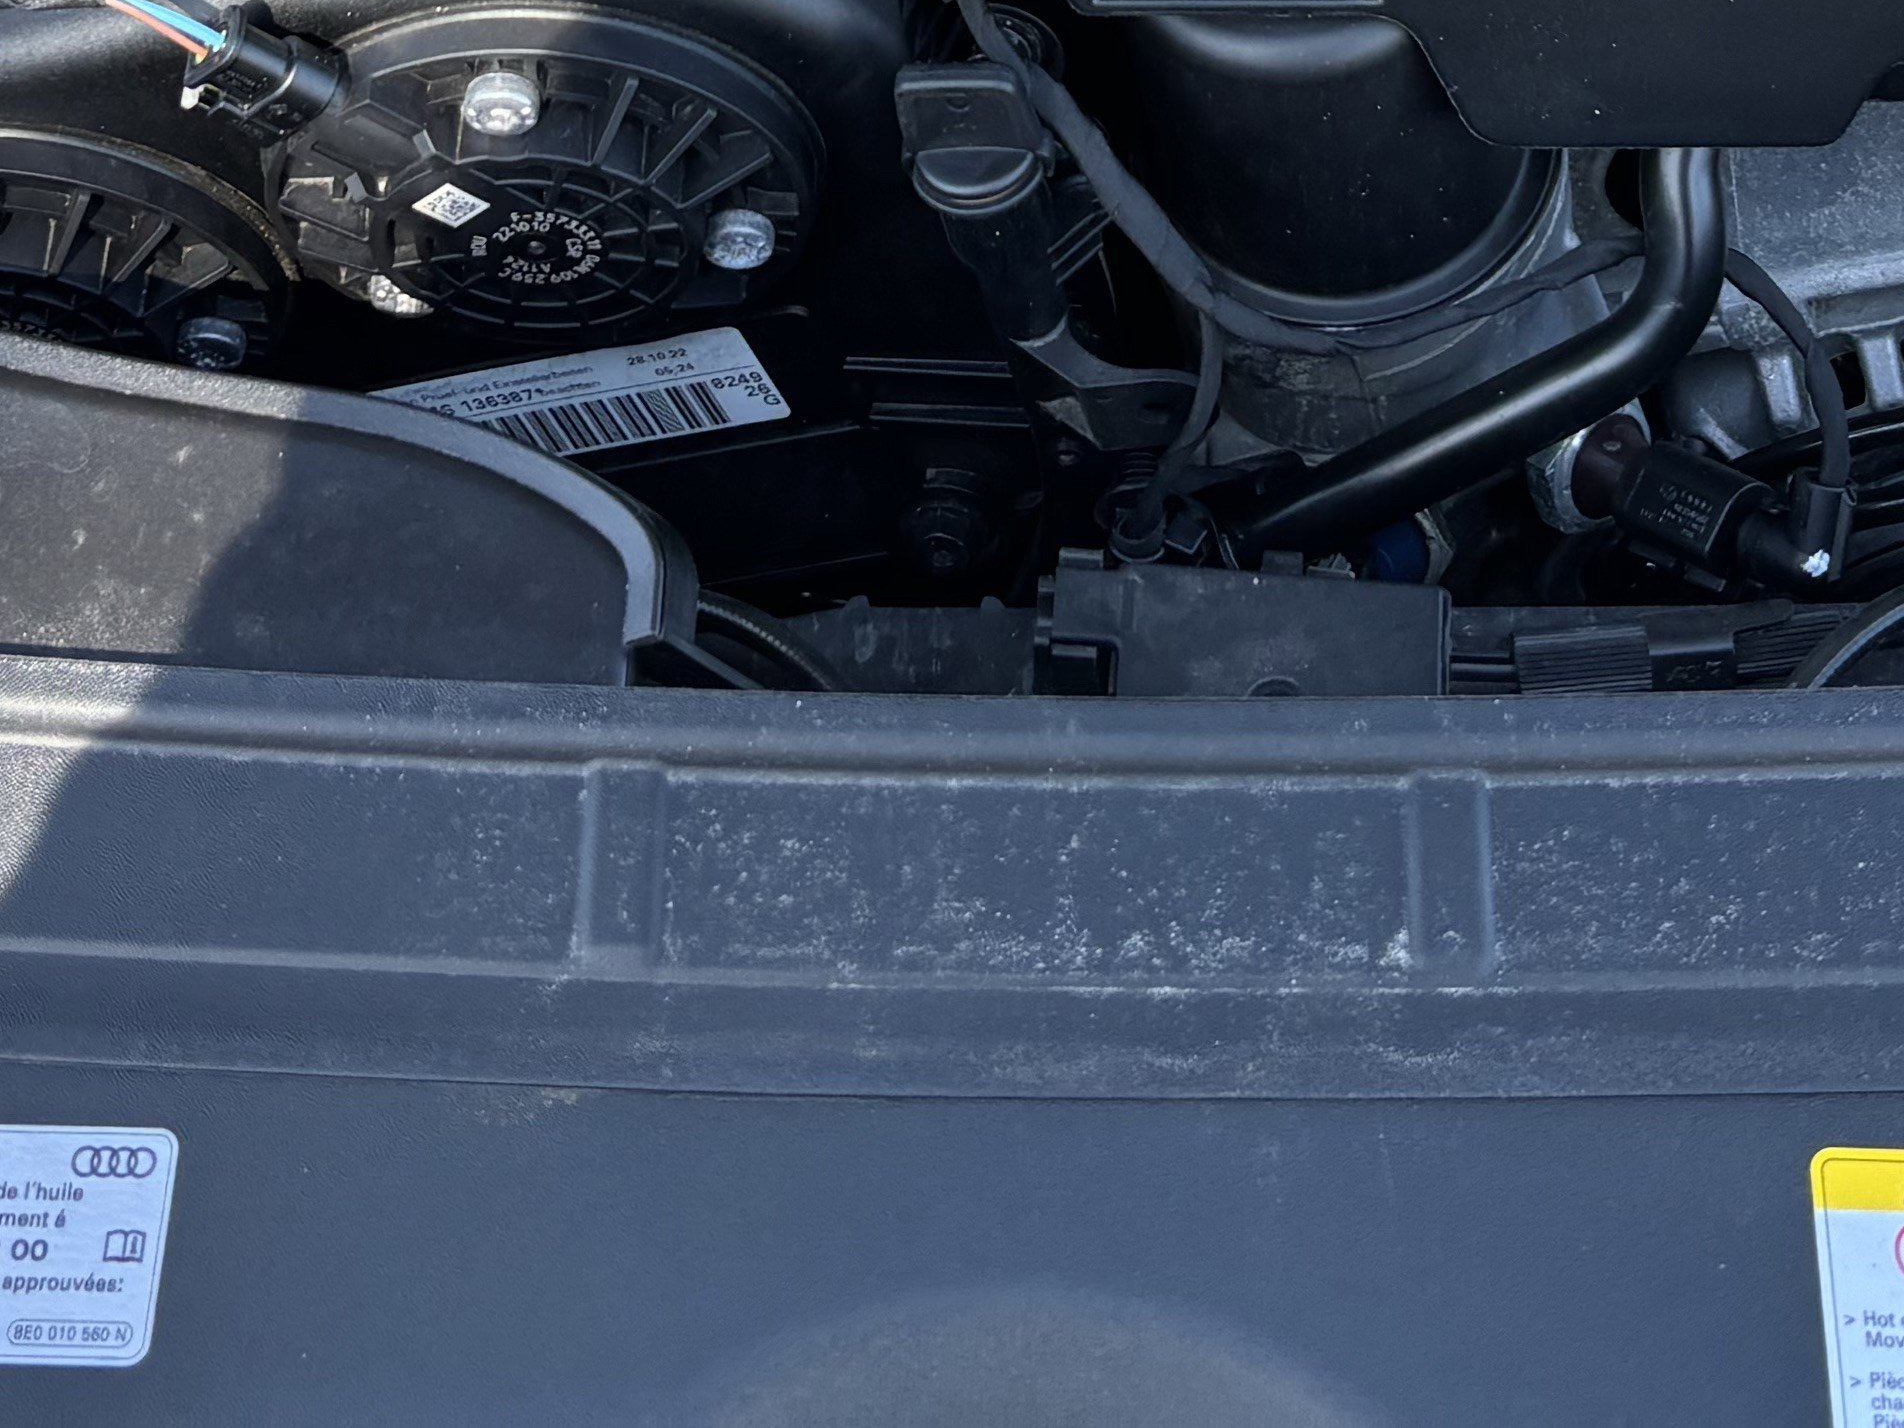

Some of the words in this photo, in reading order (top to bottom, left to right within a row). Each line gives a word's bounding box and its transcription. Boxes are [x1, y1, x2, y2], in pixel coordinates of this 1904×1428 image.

[711, 371, 763, 390] 8249
[11, 1239, 48, 1262] 00
[1, 1274, 125, 1294] approuvées:
[1863, 1310, 1896, 1327] Hot
